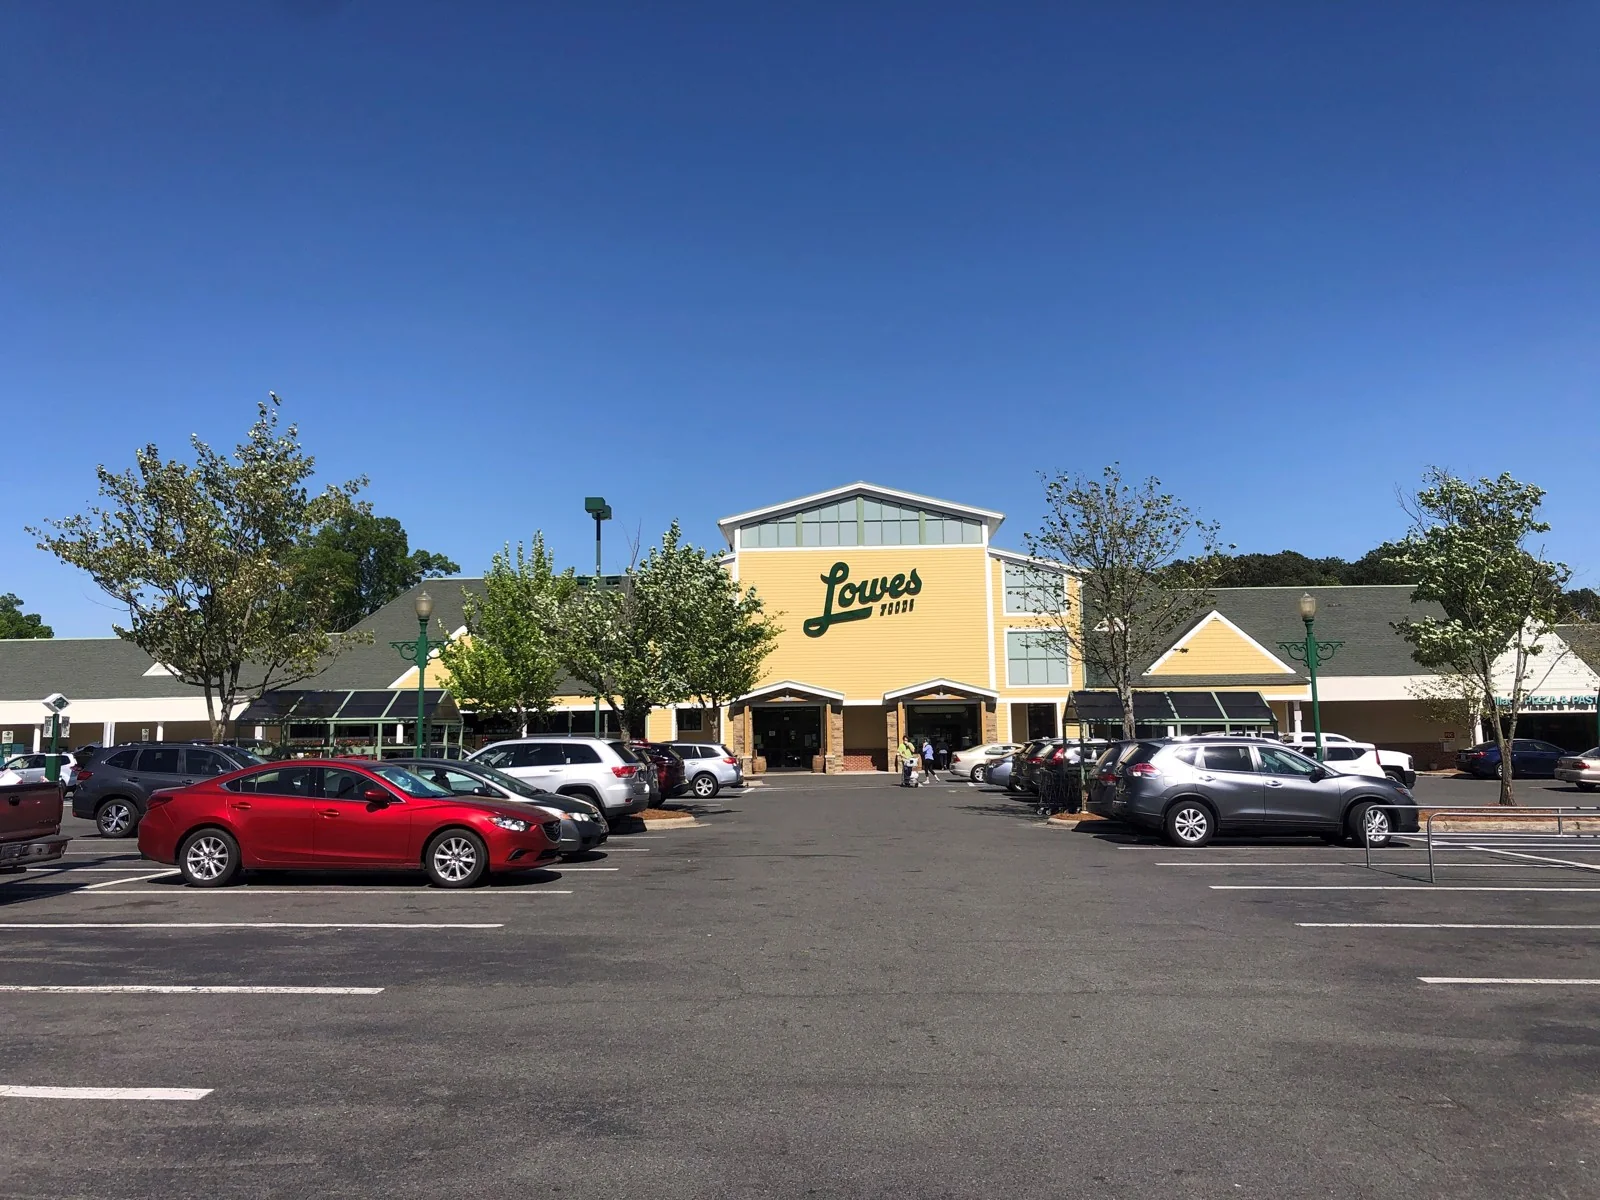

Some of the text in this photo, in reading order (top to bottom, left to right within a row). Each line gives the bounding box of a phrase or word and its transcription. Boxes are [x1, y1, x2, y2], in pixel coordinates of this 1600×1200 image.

[803, 561, 922, 638] Lowes
[1525, 695, 1558, 705] PIZZA
[1560, 695, 1569, 705] &
